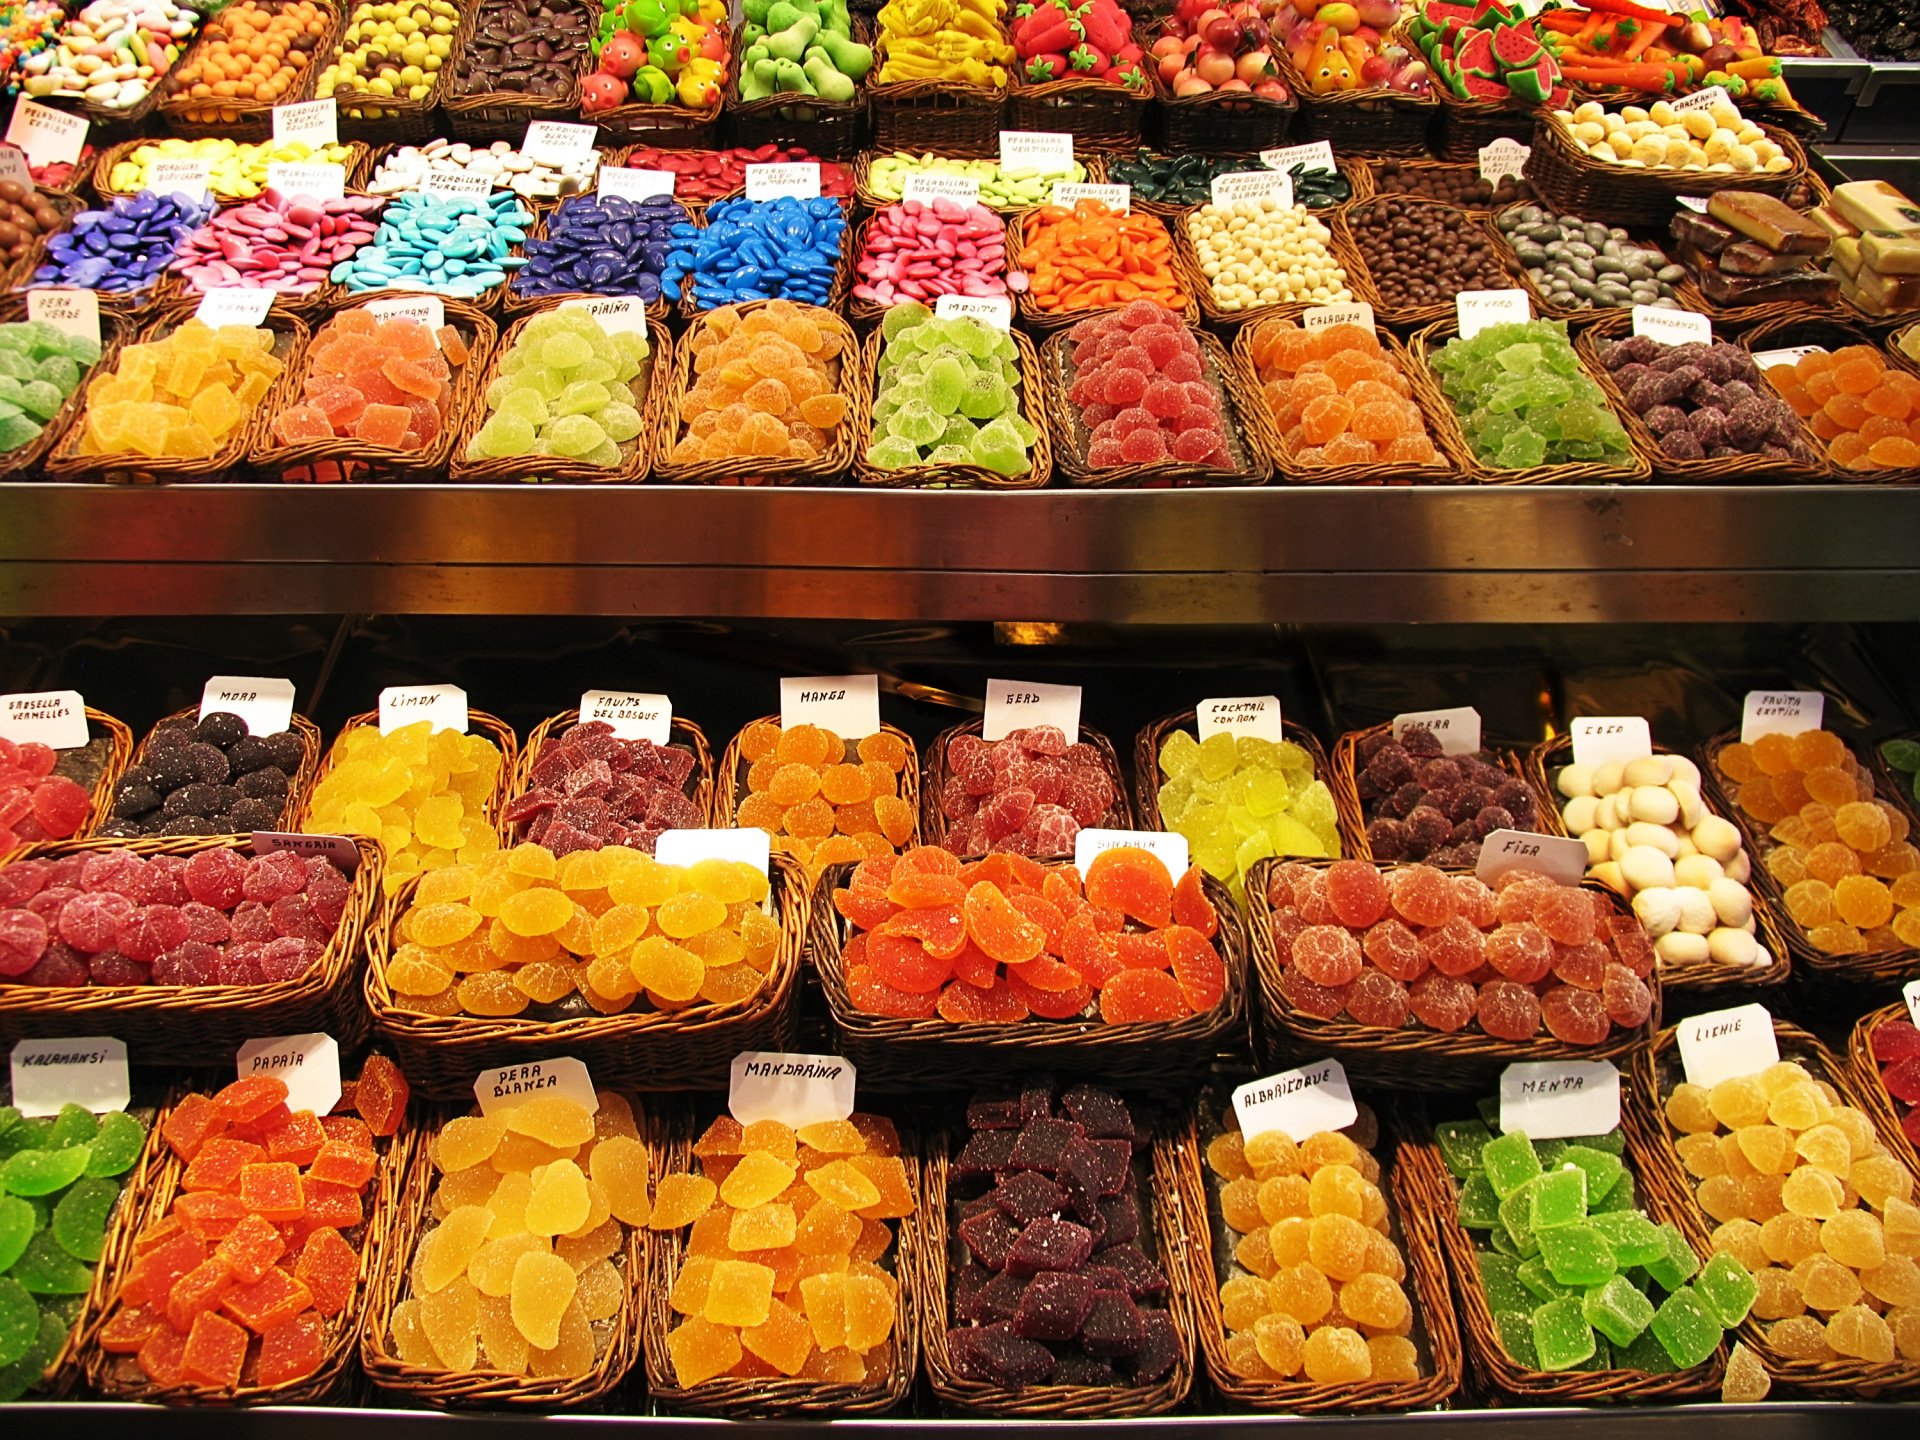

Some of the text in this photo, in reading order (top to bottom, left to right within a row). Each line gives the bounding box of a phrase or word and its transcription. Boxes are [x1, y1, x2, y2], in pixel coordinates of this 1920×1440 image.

[24, 106, 79, 129] PELADILLAS
[28, 118, 68, 136] CERISE
[538, 124, 593, 135] PELADILLAS
[752, 167, 812, 175] PELADIAS
[429, 174, 488, 186] PELADILLAS
[914, 177, 970, 188] PELADILLAS
[1060, 186, 1120, 196] PELADILLAS
[1060, 195, 1122, 205] MAINE
[38, 297, 72, 308] PERA
[586, 300, 631, 316] IPIRIÑA
[948, 302, 997, 314] MOJITO
[44, 308, 82, 320] VERDE
[1309, 312, 1361, 326] CALABAZA
[219, 691, 257, 703] MORA
[390, 693, 441, 708] LIMON
[800, 689, 847, 703] MANGO
[1005, 692, 1041, 705] GERD
[1762, 694, 1802, 706] FRUITA
[7, 698, 61, 711] GROSELLA
[596, 697, 642, 708] FRUITS
[1211, 702, 1266, 713] COCKTAIL
[12, 707, 70, 721] VERMELLES
[592, 710, 660, 722] DEL BOSQUE
[1755, 706, 1801, 717] EXOTICA
[1213, 715, 1235, 724] CON
[1584, 724, 1624, 736] COCO
[271, 838, 337, 850] SANGRIA
[1502, 840, 1541, 857] FIGA
[22, 1048, 109, 1068] KALAMANSI
[252, 1050, 305, 1072] PAPAIA
[498, 1064, 542, 1084] PERA
[744, 1058, 843, 1081] MANDARINA
[493, 1075, 558, 1098] BLANCA
[1243, 1069, 1331, 1109] ALBARICOQUE
[1522, 1076, 1585, 1094] MENTA
